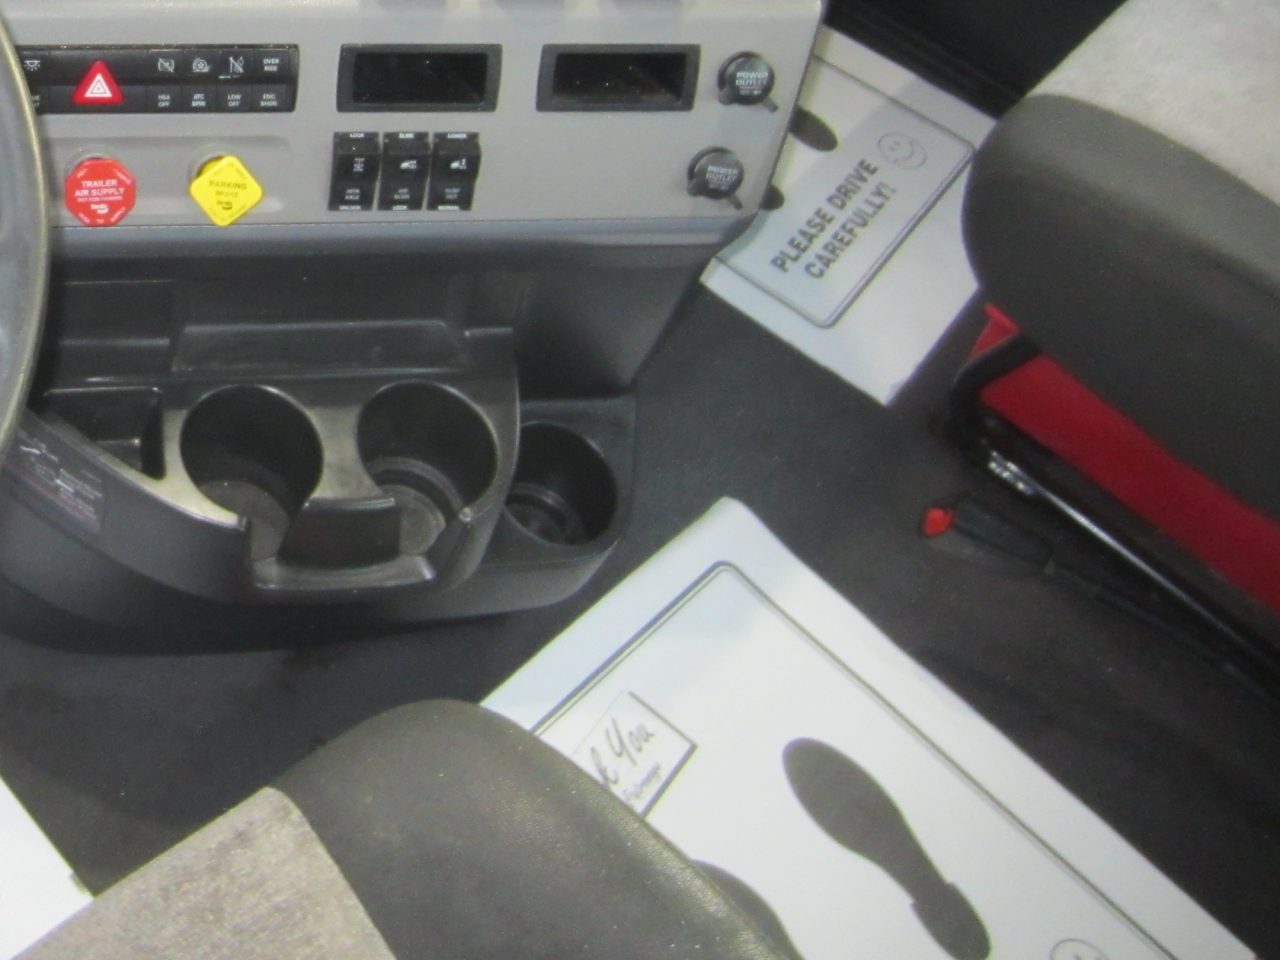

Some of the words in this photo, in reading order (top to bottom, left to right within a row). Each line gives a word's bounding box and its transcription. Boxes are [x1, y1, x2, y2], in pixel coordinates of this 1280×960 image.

[81, 179, 118, 189] TRAILER
[209, 180, 248, 190] PARKING
[74, 189, 89, 197] AIR
[91, 187, 125, 196] SUPPLY
[770, 207, 835, 273] PLEASE
[826, 159, 879, 210] DRIVE
[804, 182, 897, 279] CAREFULLY!
